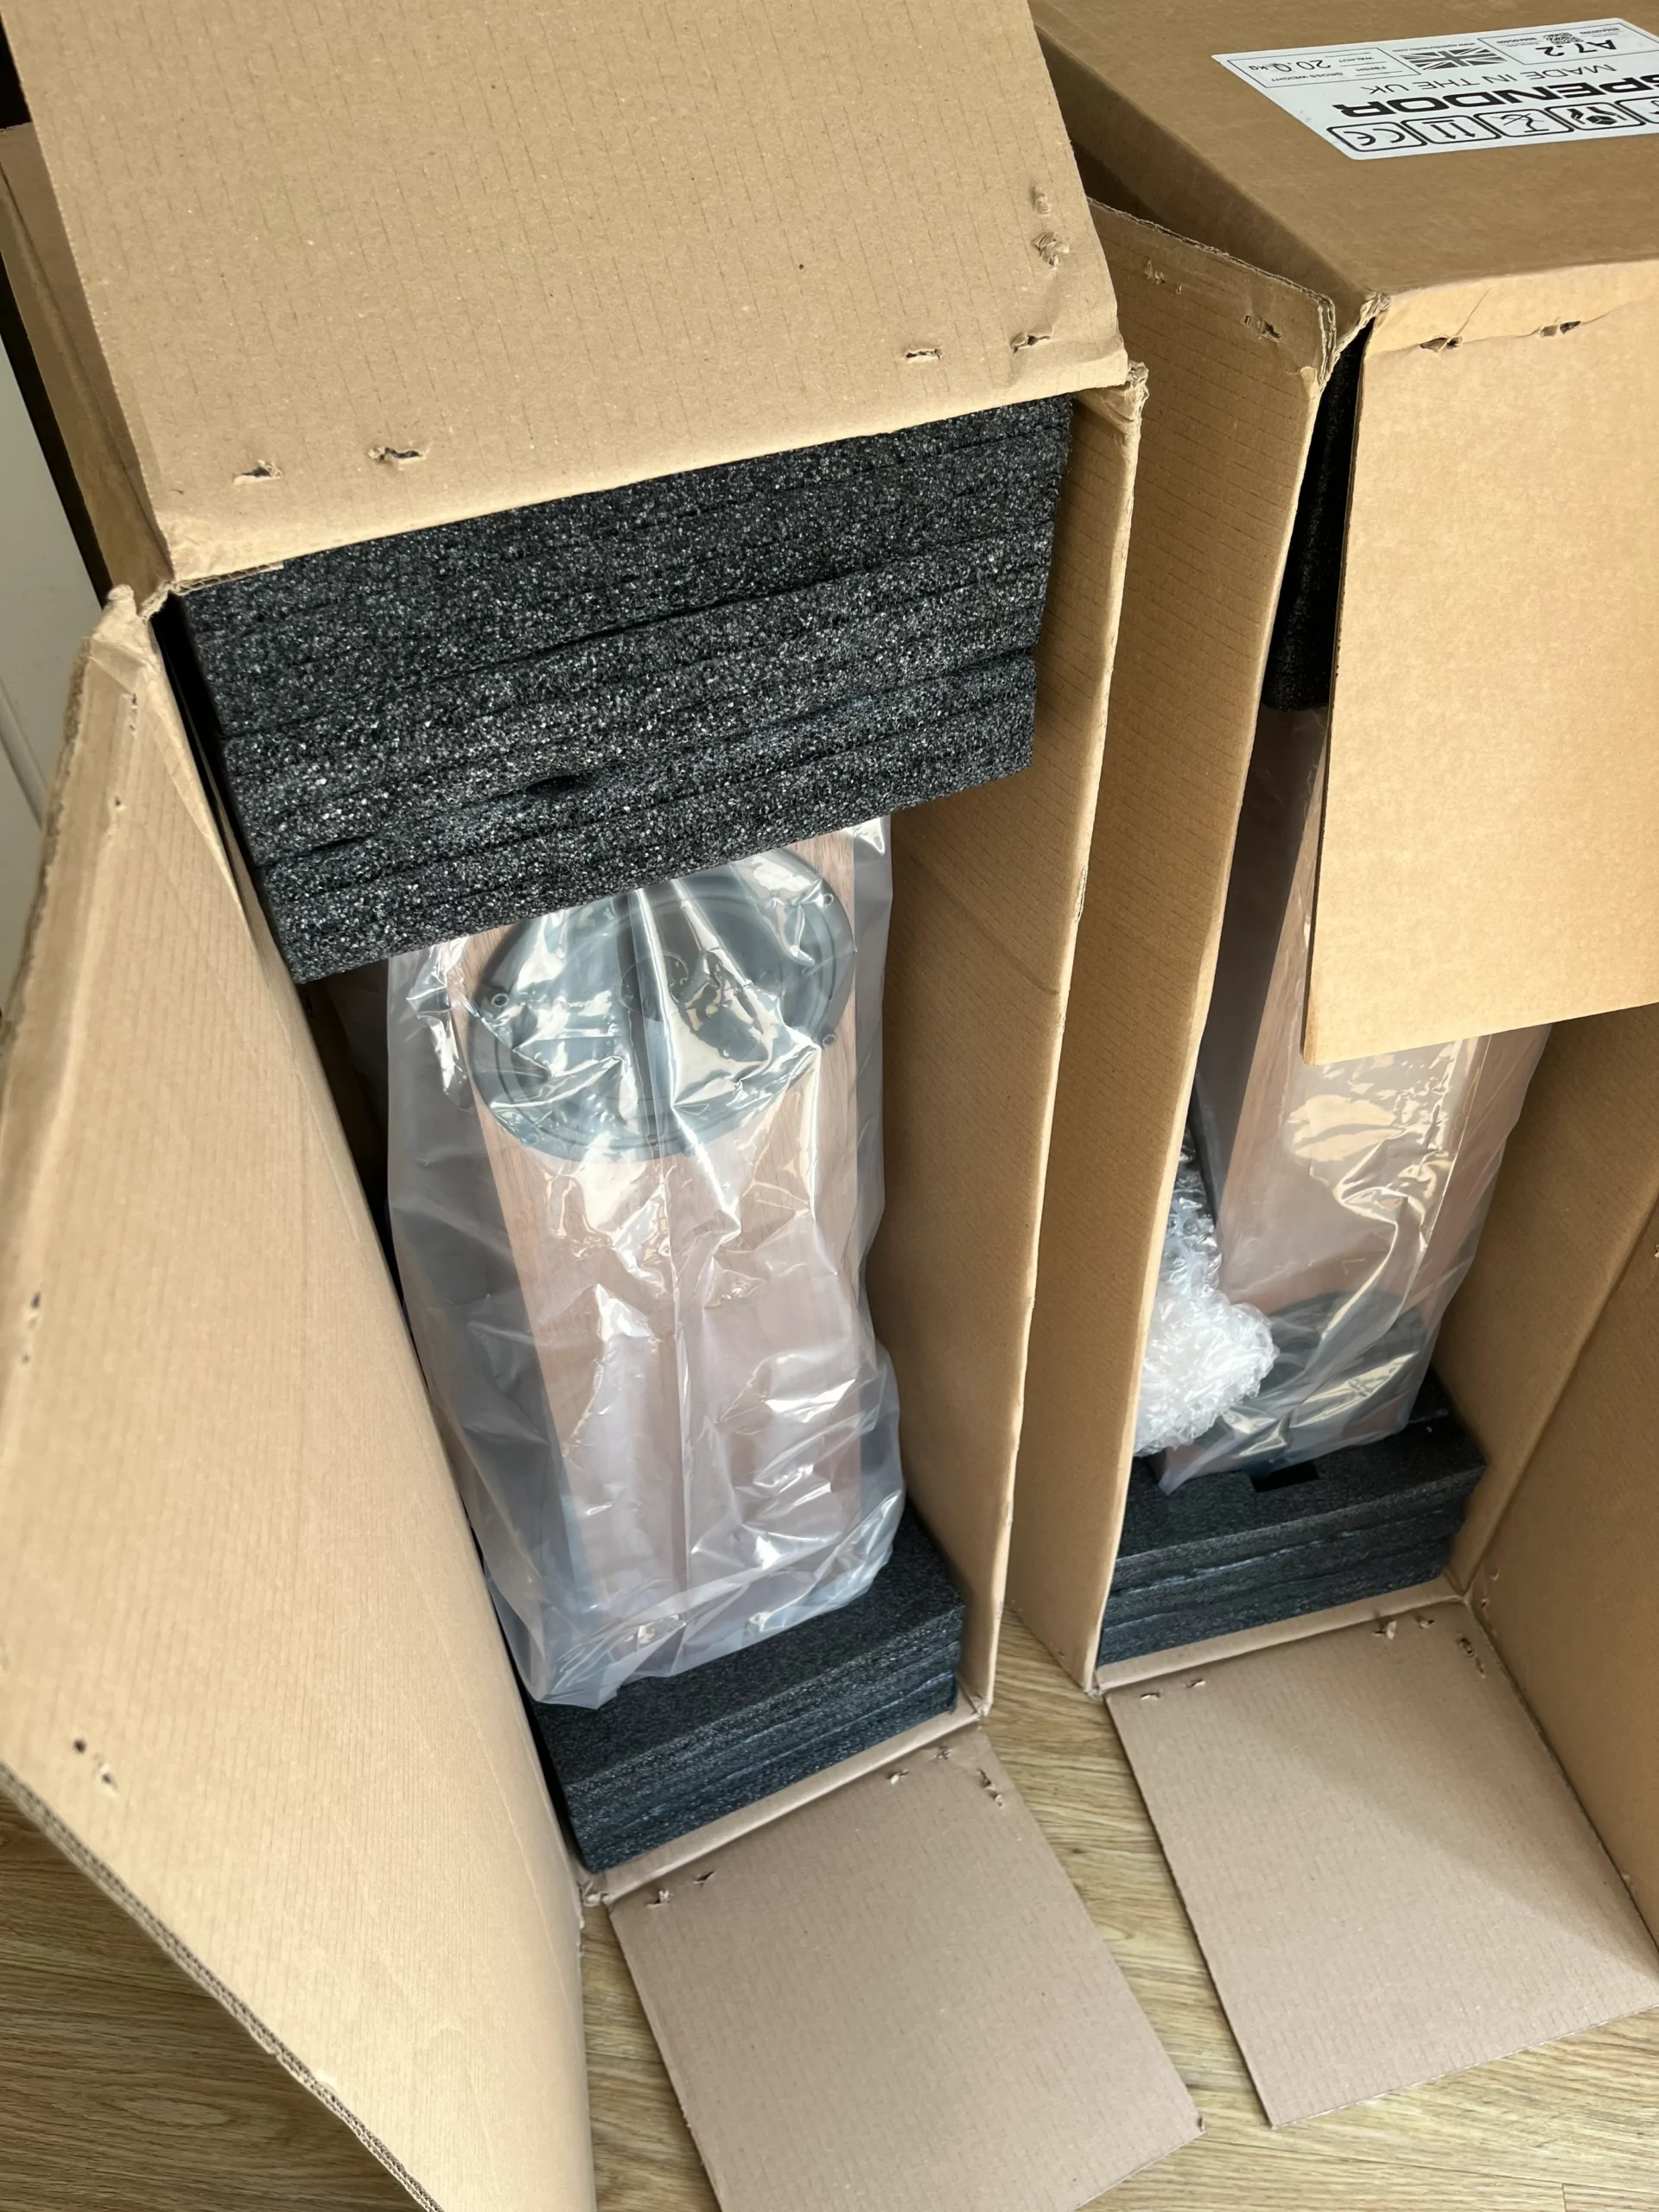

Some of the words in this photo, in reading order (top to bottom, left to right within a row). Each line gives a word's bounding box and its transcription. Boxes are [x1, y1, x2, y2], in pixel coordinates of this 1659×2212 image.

[1535, 40, 1617, 58] A7.2
[1274, 59, 1332, 73] 20.0
[1520, 64, 1617, 79] MADE
[1411, 79, 1479, 91] THE
[1480, 73, 1518, 84] IN
[1360, 84, 1409, 94] UK
